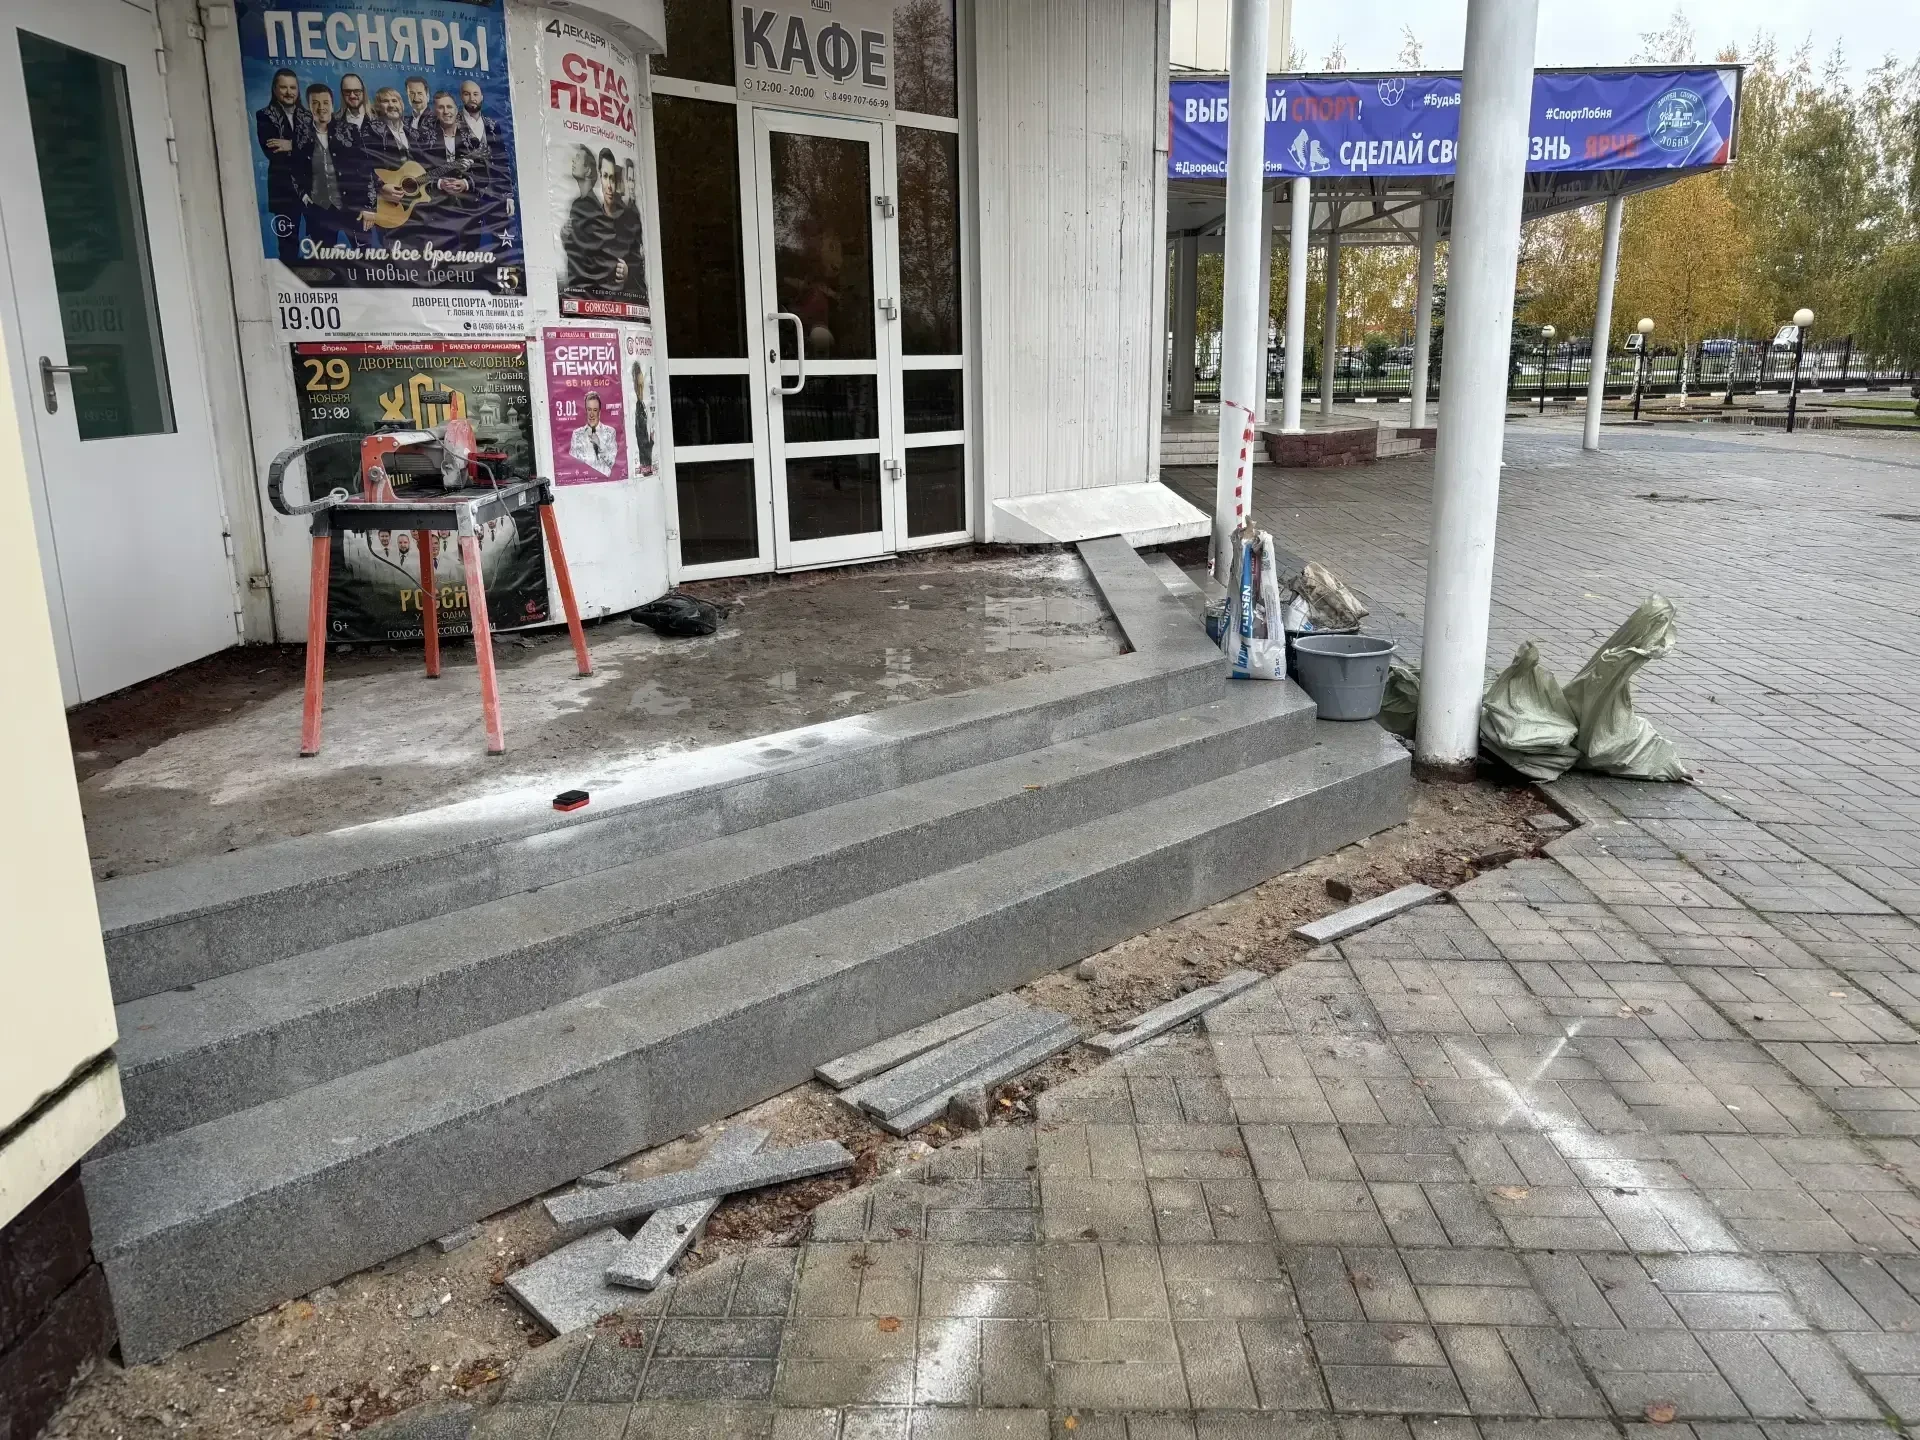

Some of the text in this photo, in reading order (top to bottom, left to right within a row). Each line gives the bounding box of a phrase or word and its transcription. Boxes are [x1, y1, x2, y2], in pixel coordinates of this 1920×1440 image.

[263, 10, 489, 72] ПЕСНЯРЫ
[545, 19, 561, 38] 4
[563, 23, 606, 48] ДЕКАБРЯ
[742, 6, 887, 88] КАФЕ
[562, 52, 629, 103] СТАС
[756, 80, 782, 93] 12:00
[789, 84, 814, 98] 20:00
[832, 91, 837, 101] 8
[550, 79, 637, 138] ПЬЕХА
[1185, 89, 1363, 123] ВЫБЙ СПОРТ!
[1545, 107, 1612, 123] #СпортЛобня
[563, 119, 614, 140] ЮБИЛЕЙНЫЙ
[1660, 135, 1689, 147] ЛОБНЯ
[1339, 132, 1423, 172] СДЕЛАЙ
[1428, 139, 1458, 164] СВ
[277, 218, 295, 231] 6+
[300, 238, 496, 268] Хиты на все времена
[347, 264, 475, 282] и новые песни
[278, 292, 339, 304] 20 НОЯБРЯ
[412, 297, 524, 309] ДВОРЕЦ СПОРТА «ЛОБНЯ»
[584, 301, 622, 314] GORKASSA.RU
[279, 306, 341, 330] 19:00
[554, 342, 615, 361] СЕРГЕЙ
[358, 355, 525, 371] ДВОРЕЦ СПОРТА «ЛОБНЯ»
[552, 361, 619, 376] ПЕНКИН
[303, 358, 350, 391] 29
[580, 379, 592, 387] НА
[593, 379, 610, 387] БИС
[308, 393, 350, 404] НОЯБРЯ
[516, 395, 527, 404] 65
[311, 406, 350, 420] 19:00
[555, 400, 578, 417] 3.01
[442, 610, 467, 620] ОДНА
[332, 620, 349, 632] 6+
[387, 628, 424, 639] ГОЛОСА
[1274, 667, 1282, 677] 25
